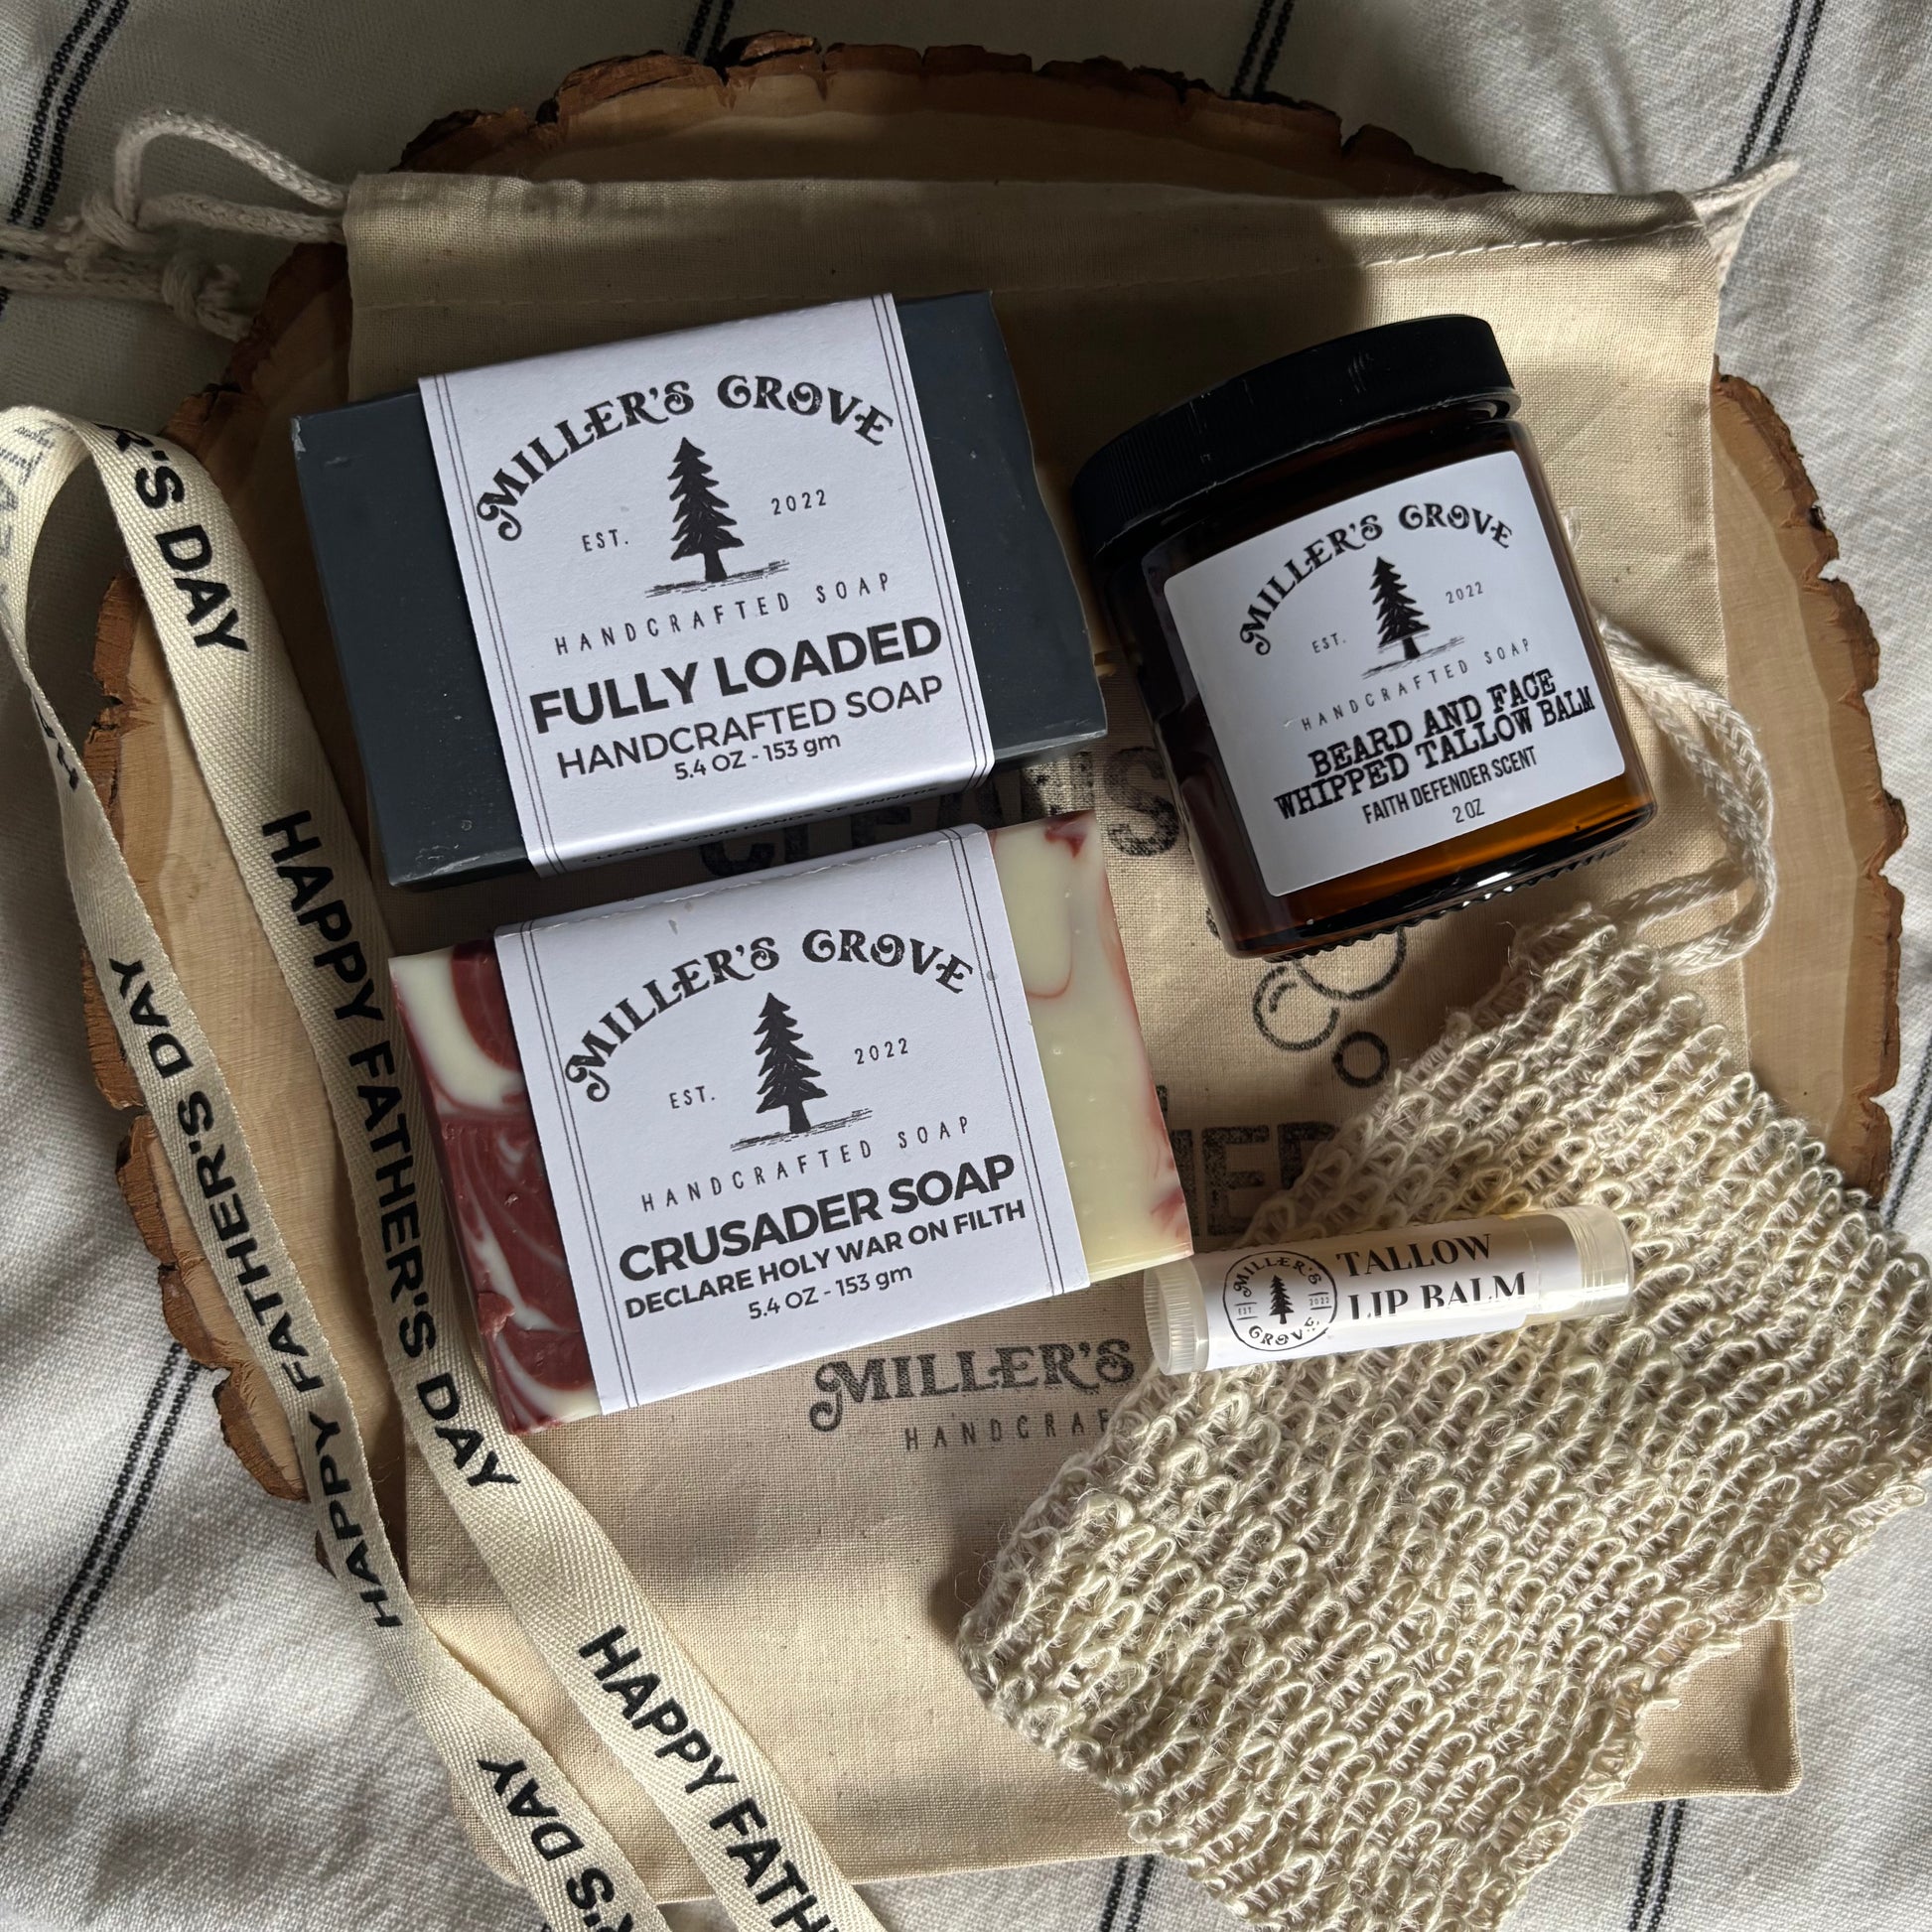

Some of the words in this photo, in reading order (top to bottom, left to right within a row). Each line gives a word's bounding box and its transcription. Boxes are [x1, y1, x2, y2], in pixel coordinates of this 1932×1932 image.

[476, 380, 694, 542] MILLER'S
[717, 374, 894, 446] GROVE
[582, 528, 630, 552] EST.
[770, 488, 827, 515] 2022
[154, 524, 249, 652] DAY
[554, 592, 789, 655] HANDCRAFTED
[816, 572, 888, 604] SOAP
[1239, 514, 1383, 656] MILLER'S
[1398, 503, 1512, 549] GROVE
[1311, 632, 1347, 654] EST.
[1446, 582, 1483, 605] 2022
[529, 661, 698, 735] FULLY
[714, 617, 942, 697] LOADED
[557, 698, 836, 779] HANDCRAFTED
[845, 675, 942, 718] SOAP
[1301, 659, 1468, 732] HANDCRAFTED
[1484, 637, 1530, 666] SOAP
[1308, 720, 1413, 778] BEARD
[1424, 695, 1482, 737] AND
[1486, 668, 1557, 714] FACE
[674, 759, 707, 780] 5.4
[712, 750, 747, 772] OZ
[763, 739, 798, 761] 153
[803, 734, 841, 758] gm
[1273, 752, 1410, 820] WHIPPED
[1417, 707, 1533, 769] TALLOW
[1540, 685, 1595, 727] BALM
[1361, 791, 1410, 824] FAITH
[1409, 763, 1492, 807] DEFENDER
[1491, 745, 1537, 778] SCENT
[1452, 806, 1464, 823] 2
[1464, 798, 1485, 819] OZ
[109, 959, 194, 1079] DAY
[564, 936, 779, 1102] MILLER'S
[801, 928, 974, 994] GROVE
[669, 1085, 717, 1109] EST.
[854, 1037, 908, 1065] 2022
[261, 809, 385, 1022] HAPPY
[348, 1039, 437, 1359] FATHER'S
[415, 1372, 516, 1487] DAY
[641, 1140, 872, 1212] HANDCRAFTED
[897, 1116, 968, 1150] SOAP
[177, 1090, 325, 1393] FATHER'S
[619, 1187, 881, 1282] CRUSADER
[888, 1154, 1015, 1214] SOAP
[624, 1269, 755, 1319] DECLARE
[758, 1248, 830, 1285] HOLY
[835, 1231, 904, 1264] WAR
[907, 1218, 949, 1245] ON
[952, 1199, 1026, 1235] FILTH
[1335, 1232, 1492, 1278] TALLOW
[749, 1297, 780, 1319] 5.4
[784, 1286, 819, 1310] OZ
[835, 1273, 871, 1297] 153
[875, 1266, 912, 1291] gm
[1233, 1256, 1322, 1298] MILLER'S
[1310, 1297, 1330, 1308] 2022
[1347, 1289, 1409, 1319] LIP
[1420, 1272, 1526, 1309] BALM
[809, 1338, 1135, 1433] MILLER'S
[308, 1411, 403, 1628] HAPPY
[578, 1624, 740, 1794] HAPPY
[477, 1758, 585, 1863] DAY
